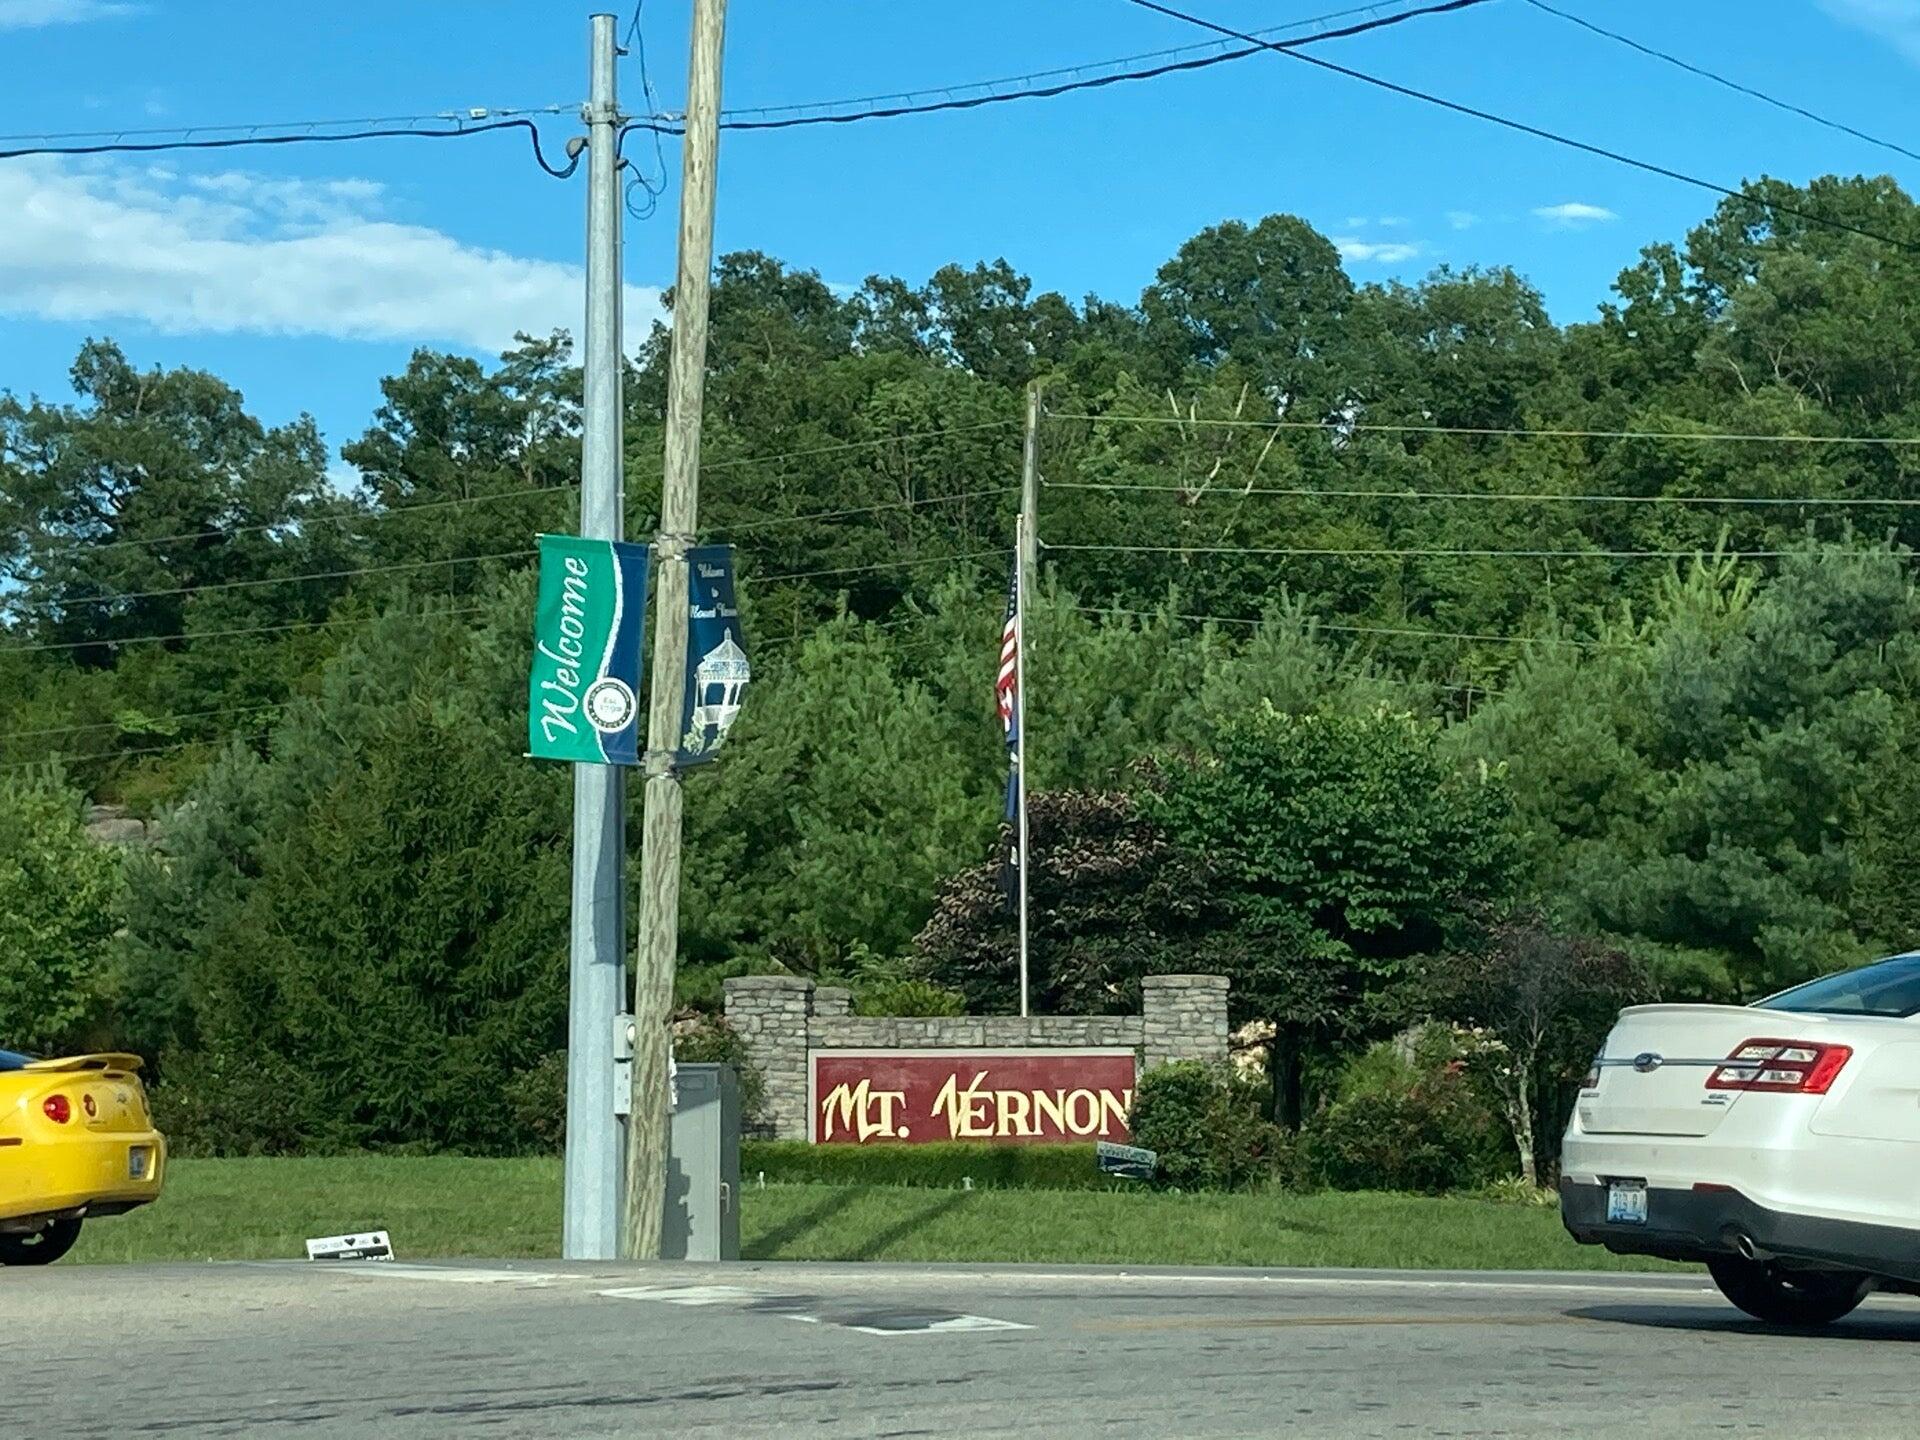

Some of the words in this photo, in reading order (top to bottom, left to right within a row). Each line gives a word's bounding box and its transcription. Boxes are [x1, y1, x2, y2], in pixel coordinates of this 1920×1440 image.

[538, 557, 590, 743] Welcome
[822, 1078, 910, 1142] MT.
[931, 1070, 1132, 1140] VERNON
